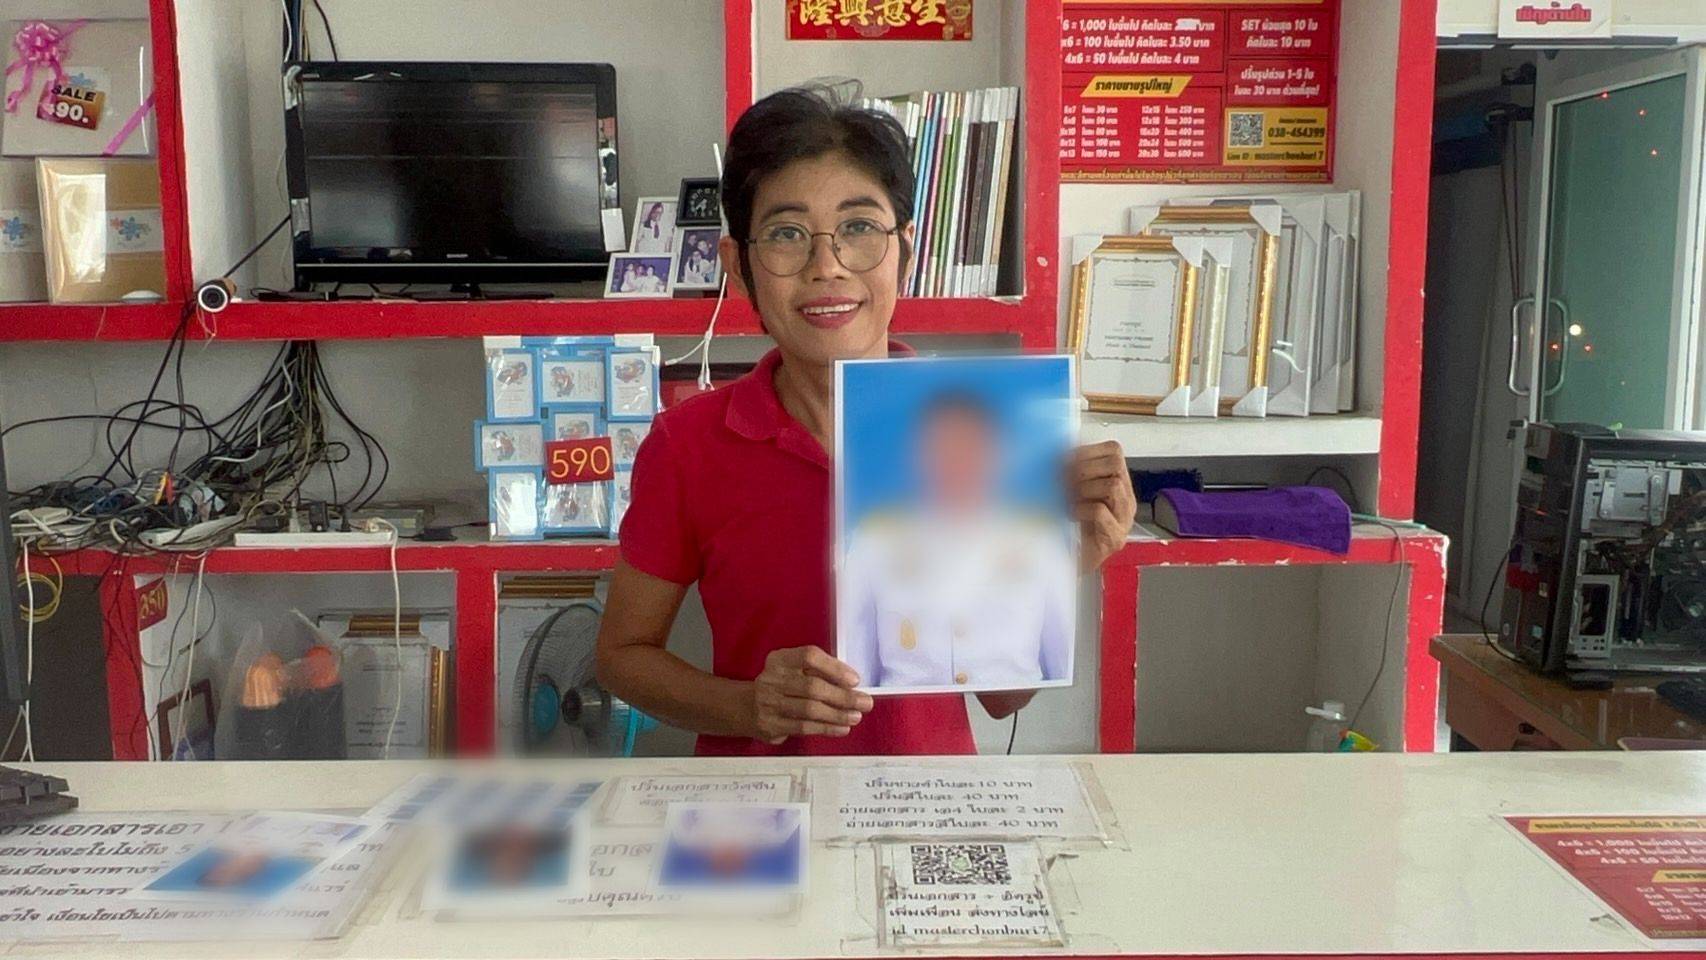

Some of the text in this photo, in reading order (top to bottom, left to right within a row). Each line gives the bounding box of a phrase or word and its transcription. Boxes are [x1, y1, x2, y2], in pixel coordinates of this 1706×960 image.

[1079, 19, 1106, 32] 1,000
[1199, 21, 1215, 31] บาท
[1241, 19, 1260, 31] SET
[1294, 19, 1306, 31] 10
[1061, 36, 1073, 47] x6
[1084, 36, 1102, 47] 100
[1170, 36, 1192, 47] 3.50
[1193, 39, 1210, 48] บาท
[1281, 36, 1293, 48] 10
[1294, 38, 1312, 48] บาท
[1065, 53, 1084, 64] 4x6
[1093, 53, 1106, 64] 50
[1174, 53, 1181, 64] 4
[1183, 55, 1200, 64] บาท
[51, 85, 96, 102] SALE
[1253, 85, 1265, 96] 30
[551, 445, 611, 478] 590
[1003, 780, 1033, 788] บาท
[963, 793, 983, 801] 40
[988, 793, 1019, 801] บาท
[839, 803, 925, 814] ถ่ายเอกสาร
[966, 803, 1006, 814] ใบละ
[1016, 806, 1026, 814] 2
[1033, 806, 1064, 814] บาท
[998, 820, 1020, 828] 40
[1026, 820, 1058, 828] บาท
[892, 924, 1049, 935] id masterchonburi7
